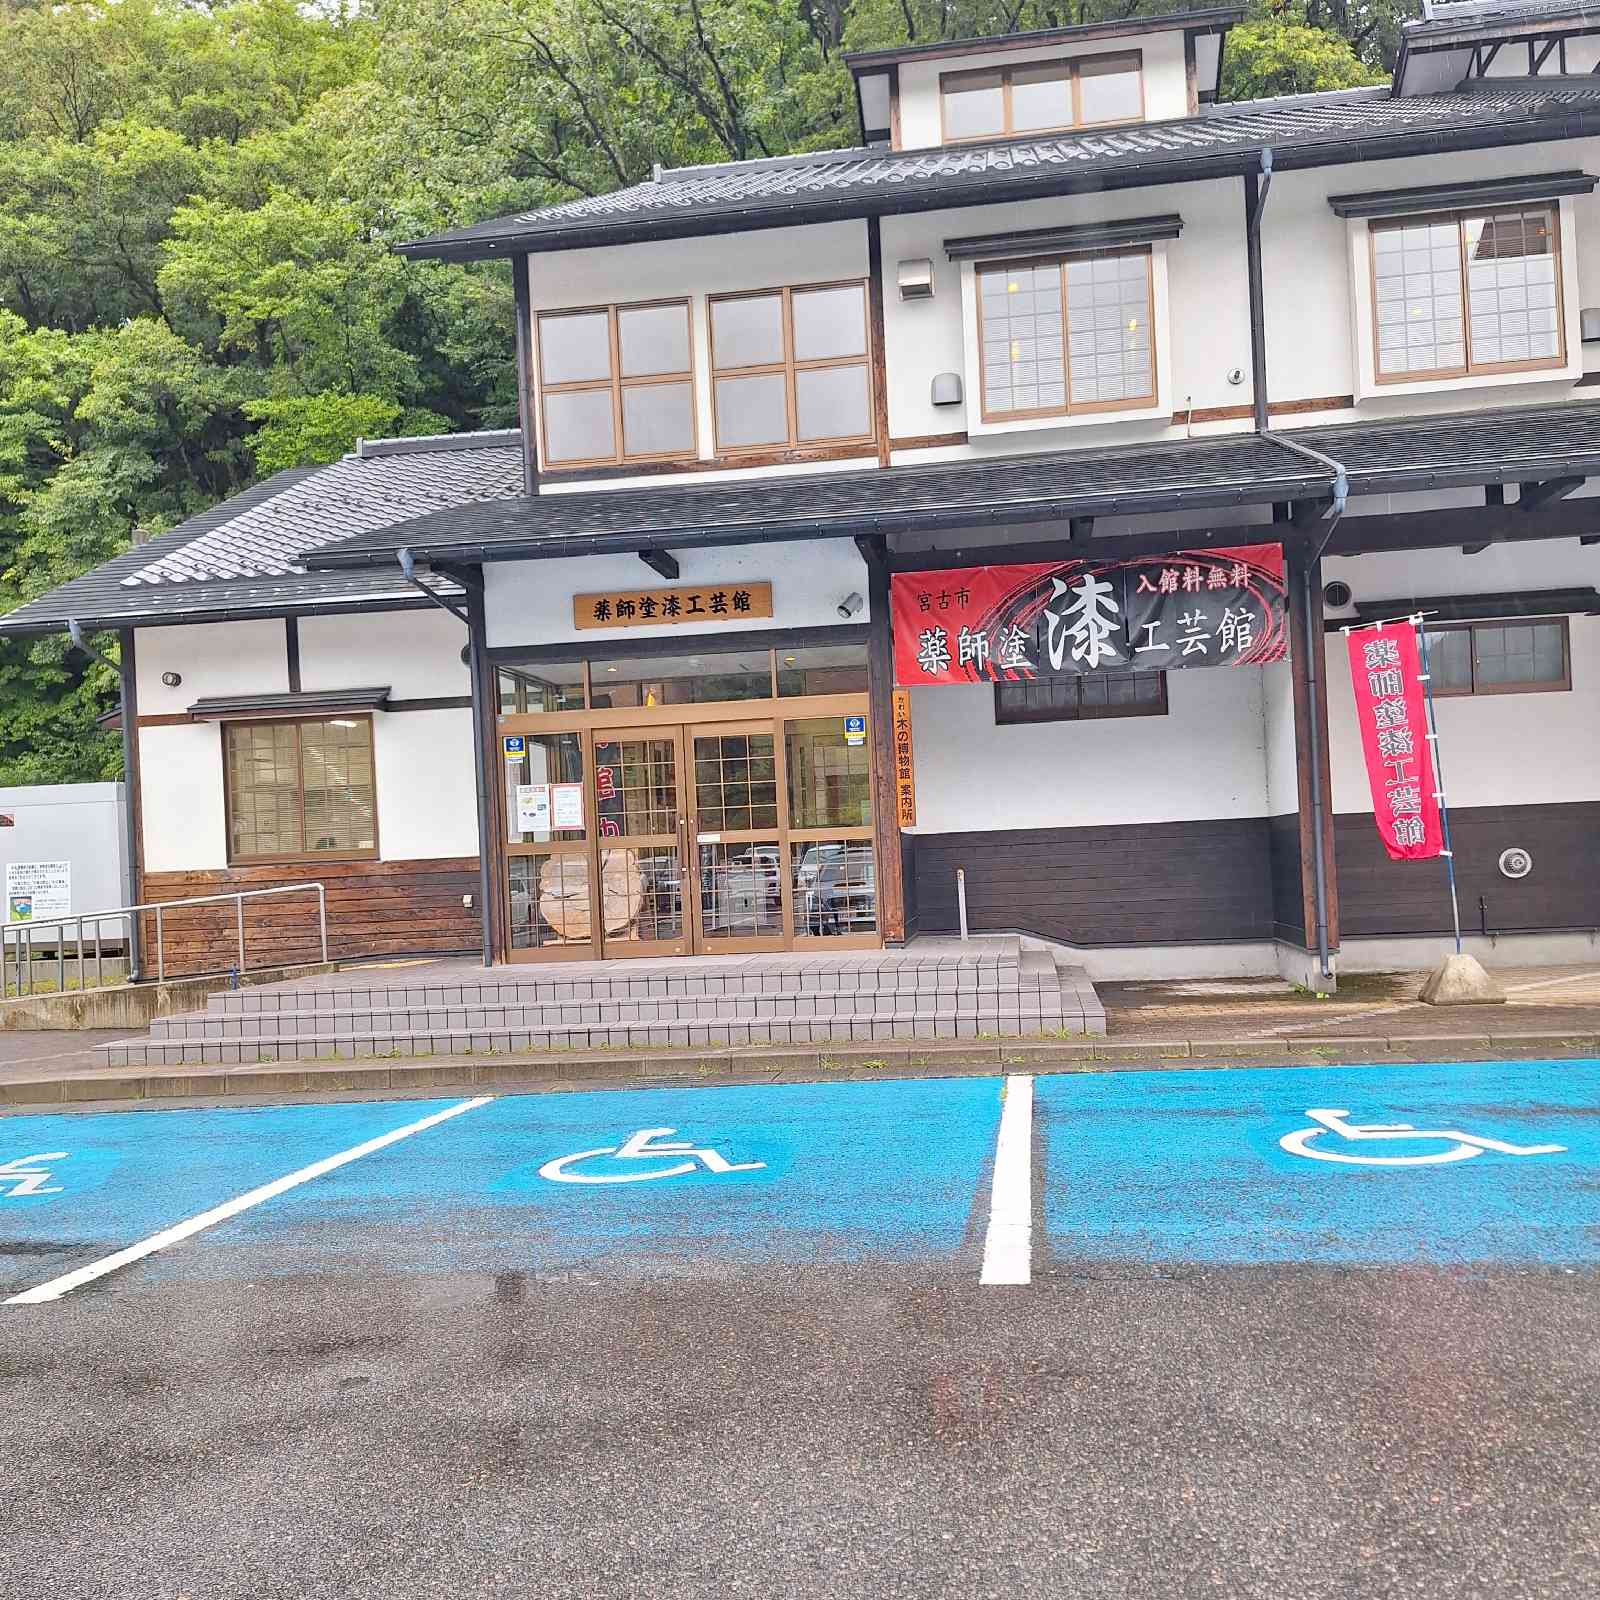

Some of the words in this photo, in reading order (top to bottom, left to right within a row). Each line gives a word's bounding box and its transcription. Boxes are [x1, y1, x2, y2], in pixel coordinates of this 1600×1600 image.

[1136, 563, 1252, 594] 入館料無料
[593, 590, 752, 622] 薬師塗漆工芸館
[916, 586, 971, 612] 宮古市
[917, 573, 1256, 675] 薬師塗漆工芸館
